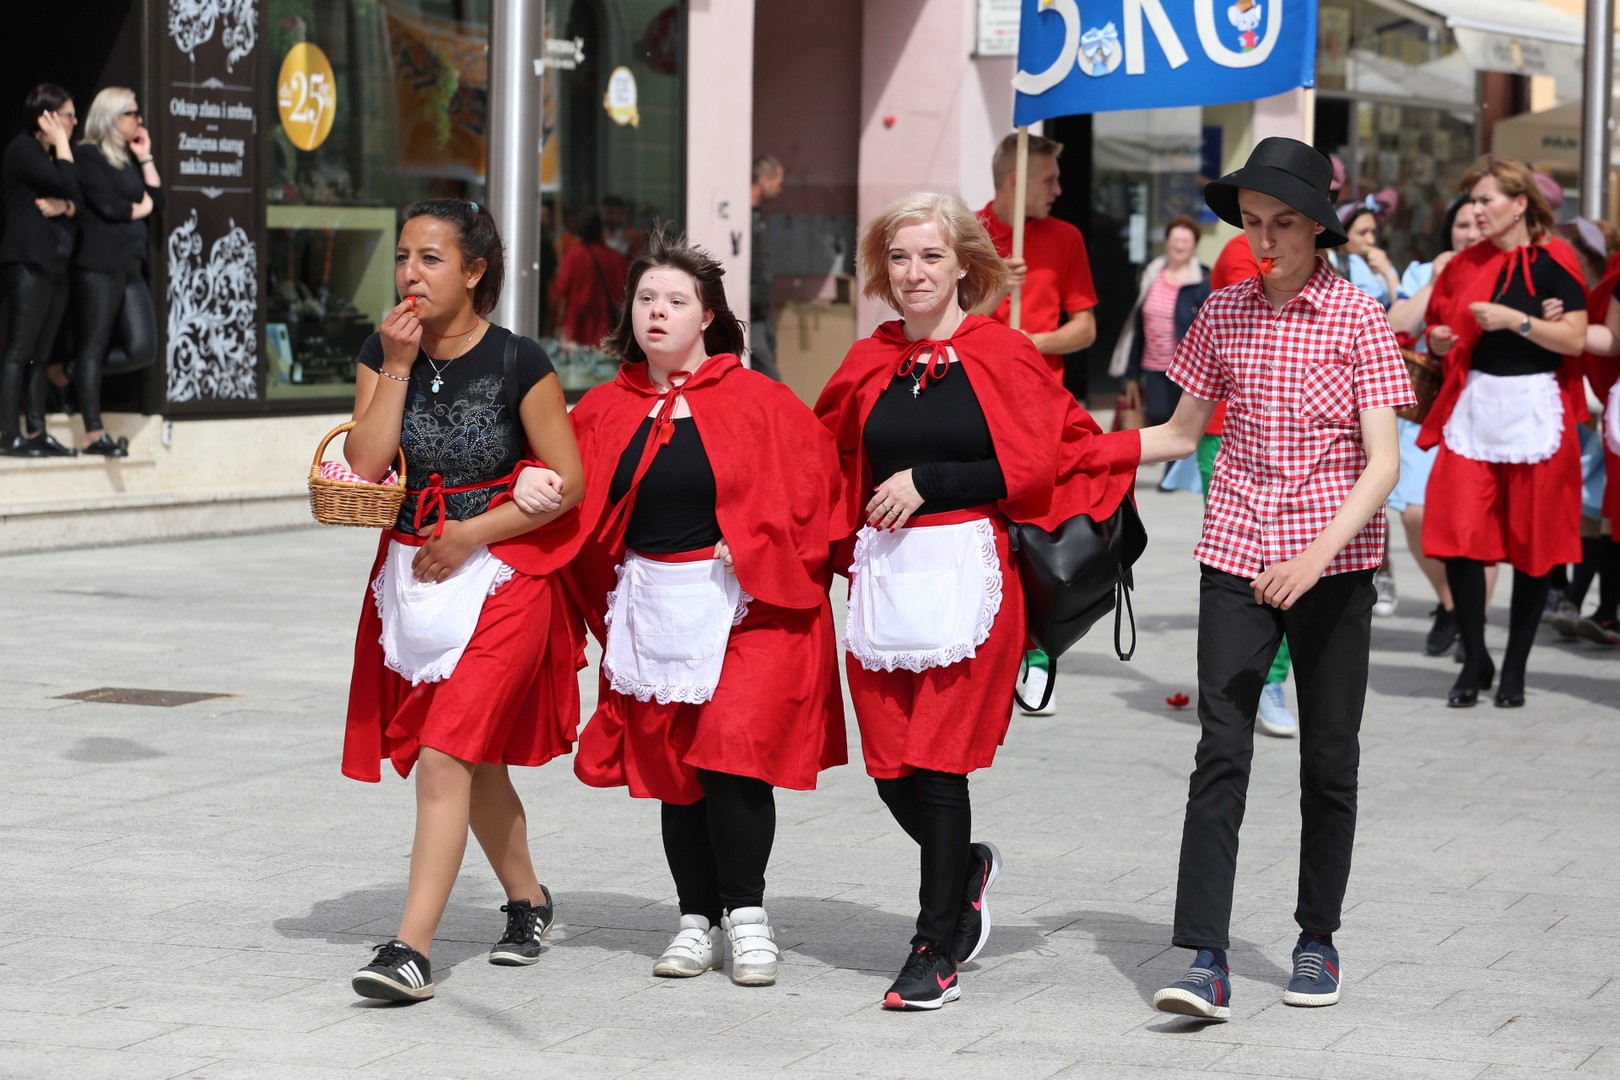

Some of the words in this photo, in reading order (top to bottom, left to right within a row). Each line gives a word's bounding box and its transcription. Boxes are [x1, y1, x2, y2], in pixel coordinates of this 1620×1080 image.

[169, 97, 198, 121] Otkup
[199, 99, 221, 119] zlata
[178, 131, 217, 155] Zamjena
[179, 156, 208, 175] nakita
[208, 161, 220, 176] za
